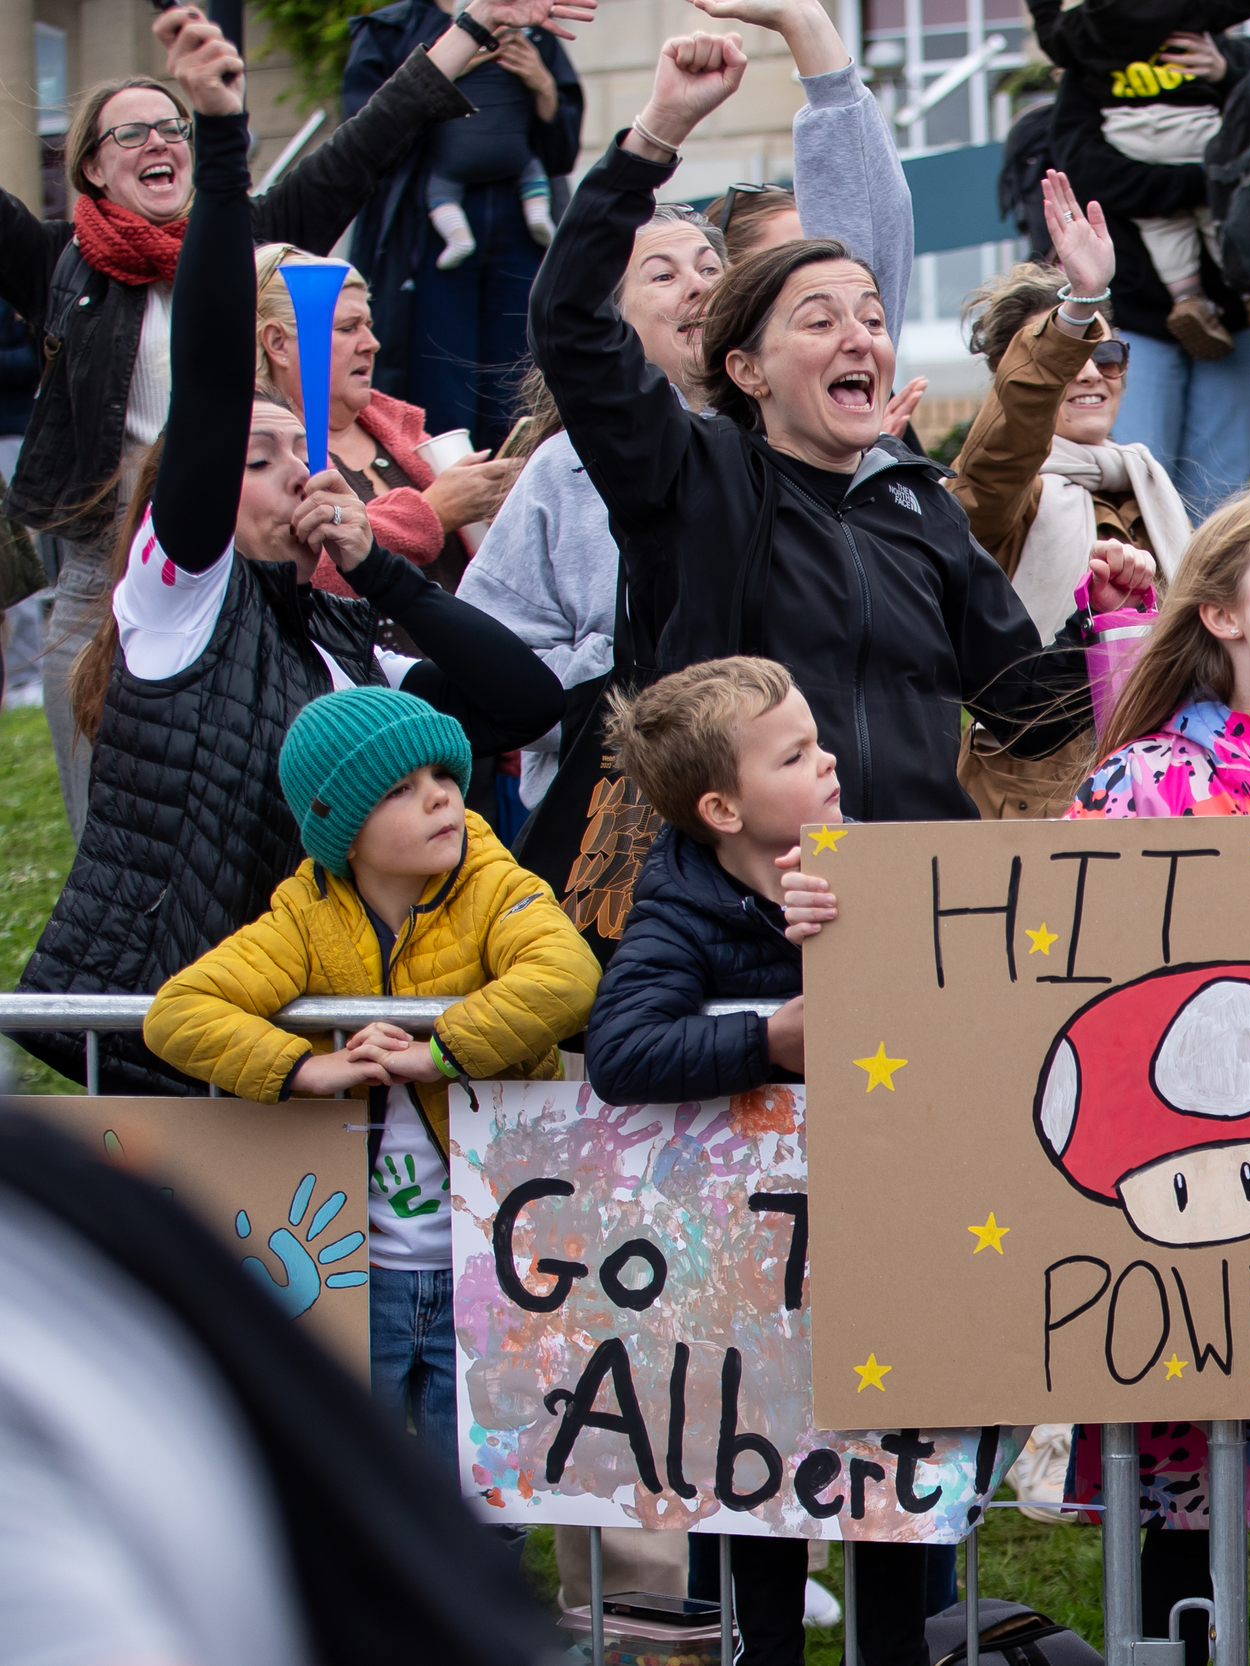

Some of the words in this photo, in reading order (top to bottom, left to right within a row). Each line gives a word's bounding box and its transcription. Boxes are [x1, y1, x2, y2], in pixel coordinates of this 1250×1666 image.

[895, 495, 911, 510] FACE
[896, 482, 910, 496] THE
[931, 847, 1221, 988] HIT
[492, 1177, 668, 1313] Go
[543, 1337, 1000, 1526] Albert!
